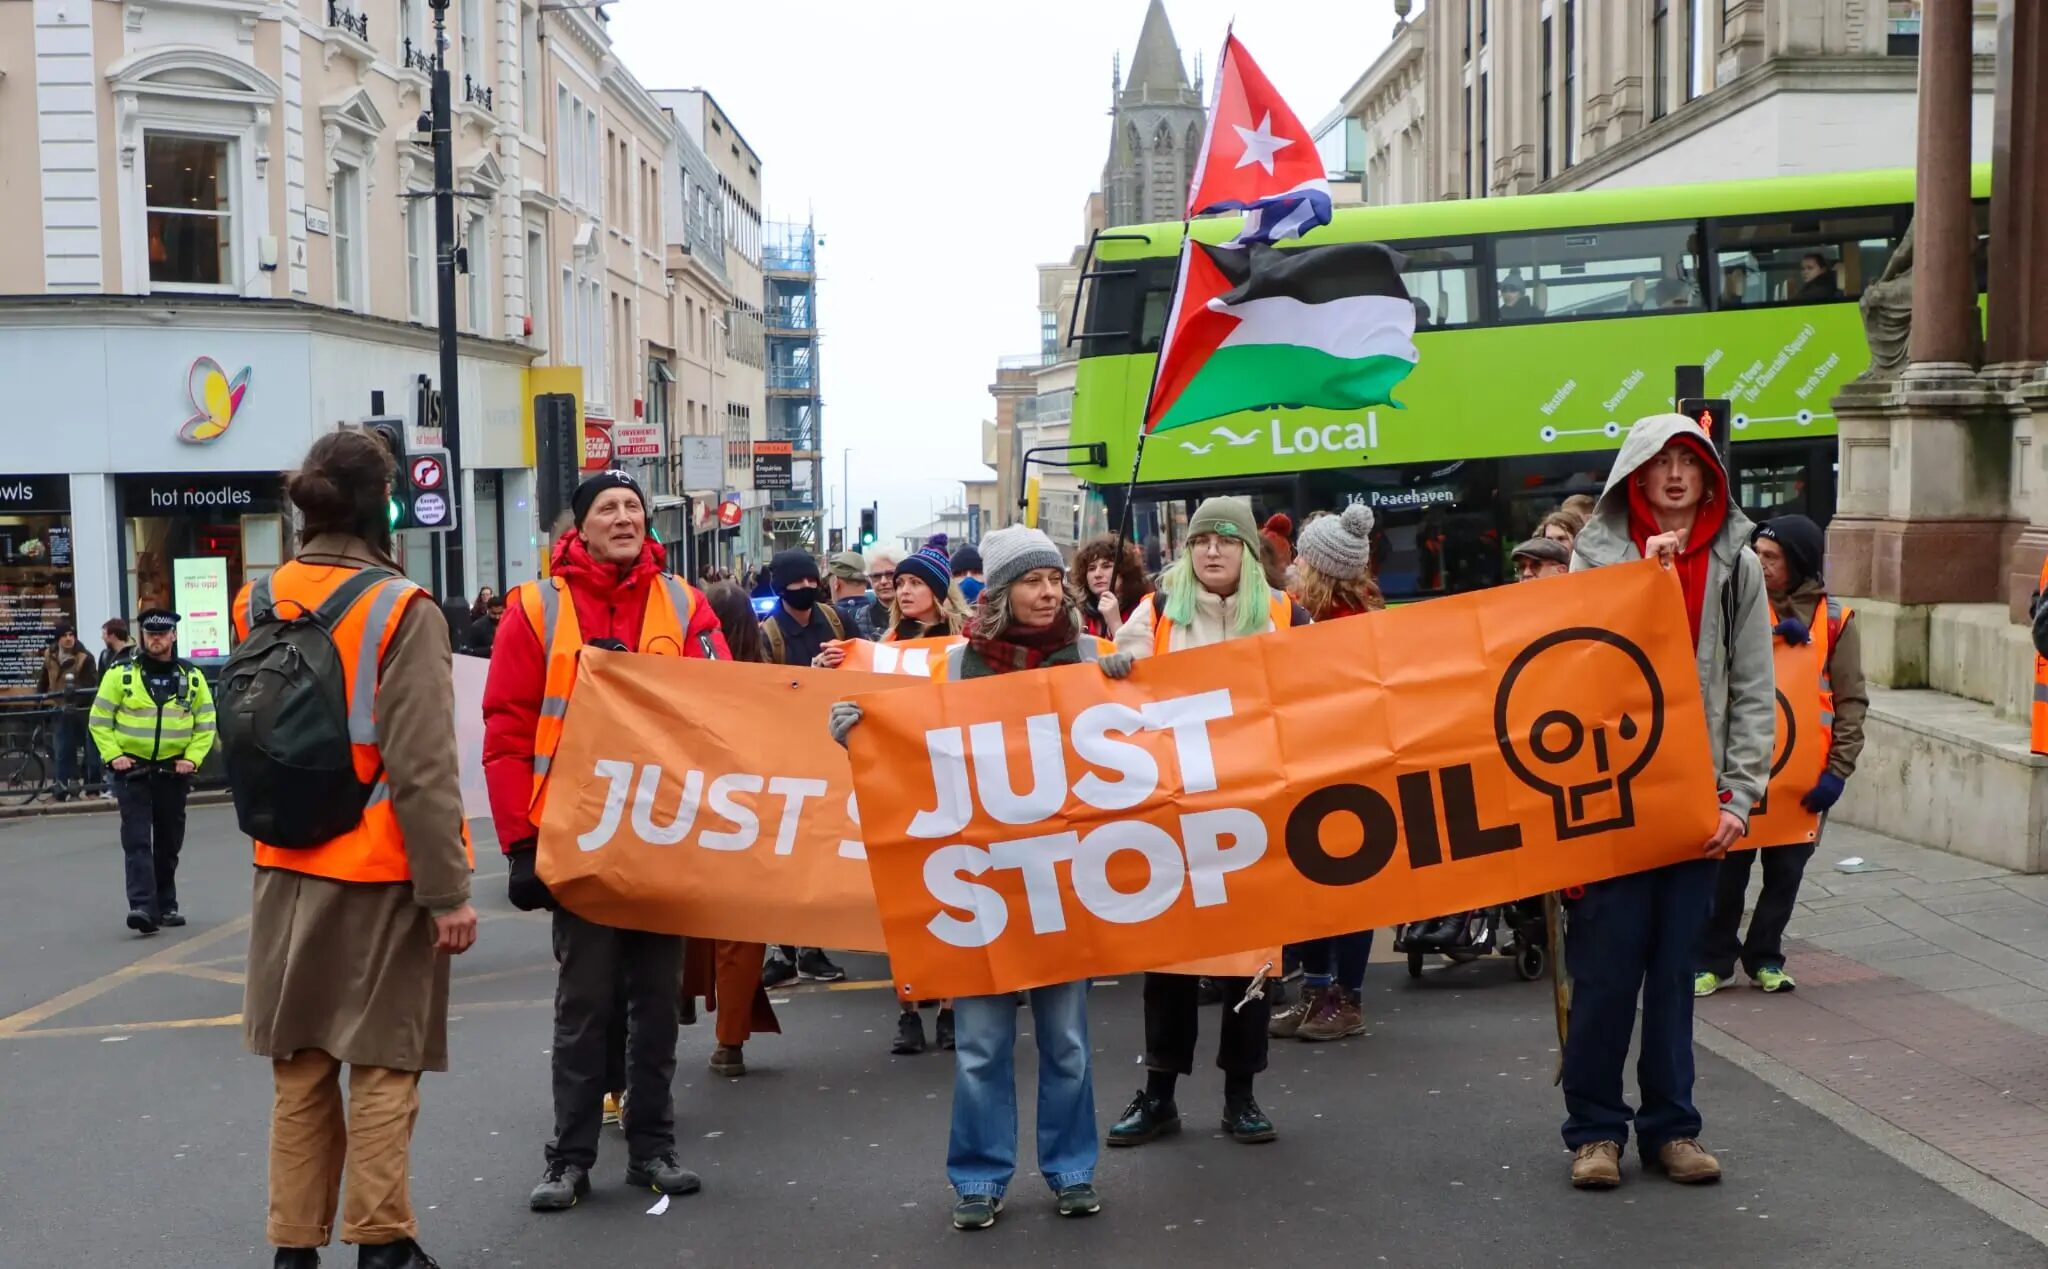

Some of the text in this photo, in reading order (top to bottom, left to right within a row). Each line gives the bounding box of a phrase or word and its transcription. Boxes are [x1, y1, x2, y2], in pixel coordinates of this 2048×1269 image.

[1754, 353, 1788, 388] Churchill
[1784, 323, 1816, 358] Square)
[1739, 359, 1765, 384] Tower
[1795, 352, 1841, 400] North Street
[1602, 368, 1645, 412] Seven Dials
[617, 428, 657, 437] CONVENIENCE
[1271, 411, 1378, 455] Local
[619, 445, 656, 454] OFF LICENCE
[756, 465, 782, 473] Enquiries
[0, 482, 33, 501] wls
[151, 486, 251, 506] hot noodles
[420, 497, 439, 505] Except
[1371, 488, 1455, 506] Peacehaven
[906, 688, 1234, 839] JUST
[577, 759, 828, 856] JUST
[922, 807, 1269, 949] STOP
[1284, 763, 1523, 887] OIL
